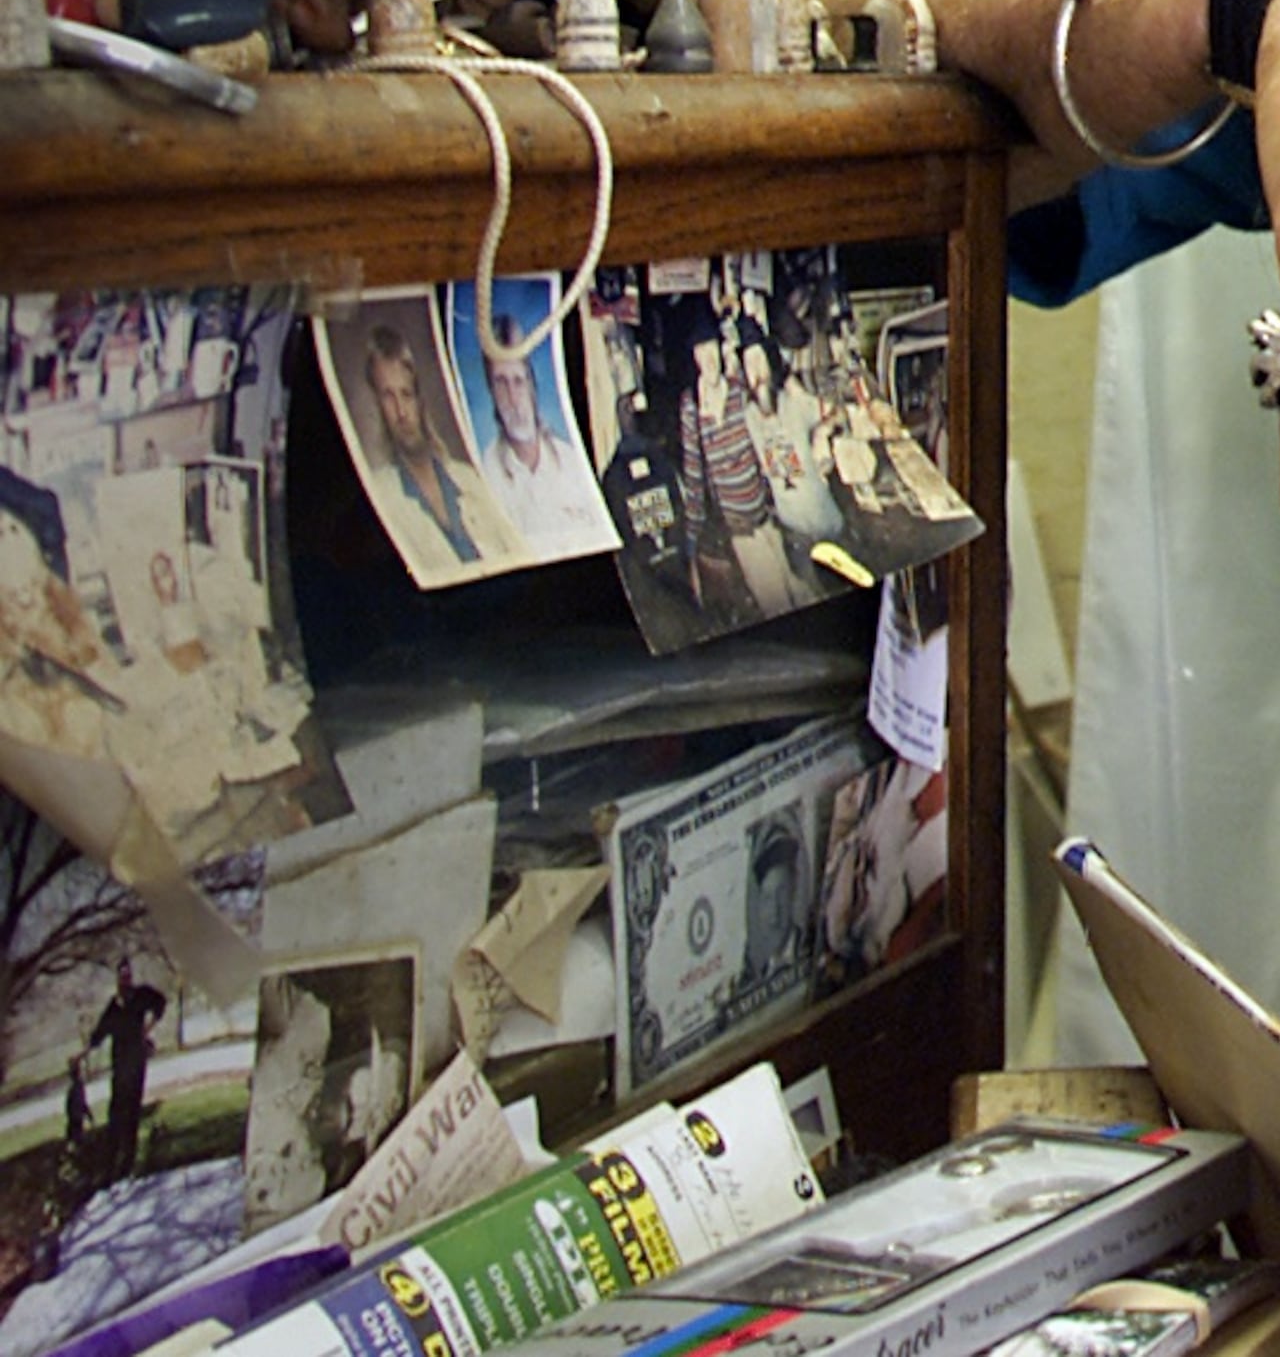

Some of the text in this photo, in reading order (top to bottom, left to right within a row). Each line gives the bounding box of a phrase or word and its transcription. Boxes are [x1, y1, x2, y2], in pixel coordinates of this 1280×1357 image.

[341, 1145, 420, 1250] Civil
[414, 1071, 484, 1156] War
[606, 1160, 641, 1194] 3
[588, 1177, 652, 1288] FILM
